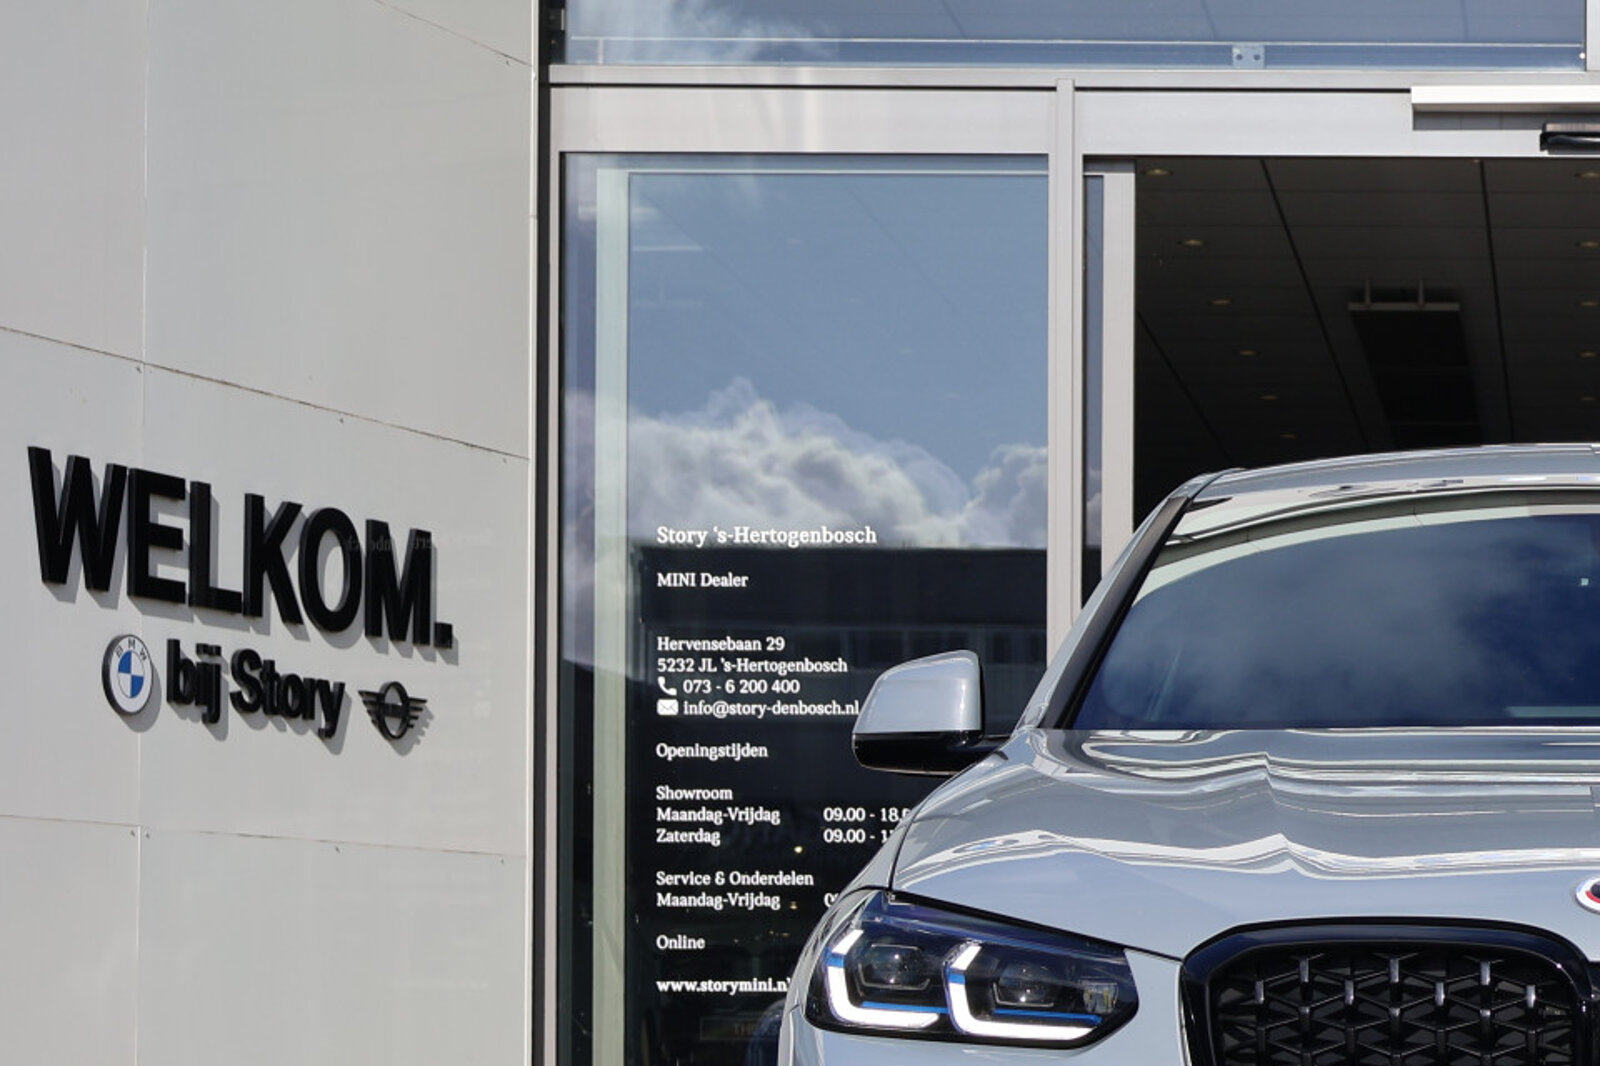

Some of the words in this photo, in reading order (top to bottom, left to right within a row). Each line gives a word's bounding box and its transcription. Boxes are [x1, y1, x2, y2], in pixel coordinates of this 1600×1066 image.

[656, 525, 709, 548] Story
[28, 446, 453, 649] WELKOM.
[657, 572, 696, 588] MINI
[700, 572, 749, 588] Dealer
[657, 636, 762, 652] Hervensebaan
[766, 637, 786, 651] 29
[657, 658, 695, 673] 5232
[698, 658, 718, 673] JL
[166, 638, 222, 725] bij
[230, 648, 346, 739] Story
[682, 679, 713, 694] 073
[725, 679, 736, 694] 6
[739, 679, 768, 694] 200
[771, 679, 801, 694] 400
[683, 699, 859, 718] info@story-denbosch.nl
[656, 743, 769, 760] Openingstijden
[656, 785, 733, 801] Showroom
[656, 807, 781, 826] Maandag-Vrijdag
[823, 807, 866, 822] 09.00
[656, 828, 721, 846] Zaterdag
[823, 829, 866, 844] 09.00
[656, 871, 712, 886] Service
[714, 871, 726, 886] &
[728, 871, 814, 886] Onderdelen
[656, 892, 781, 911] Maandag-Vrijdag
[656, 935, 706, 950] Online
